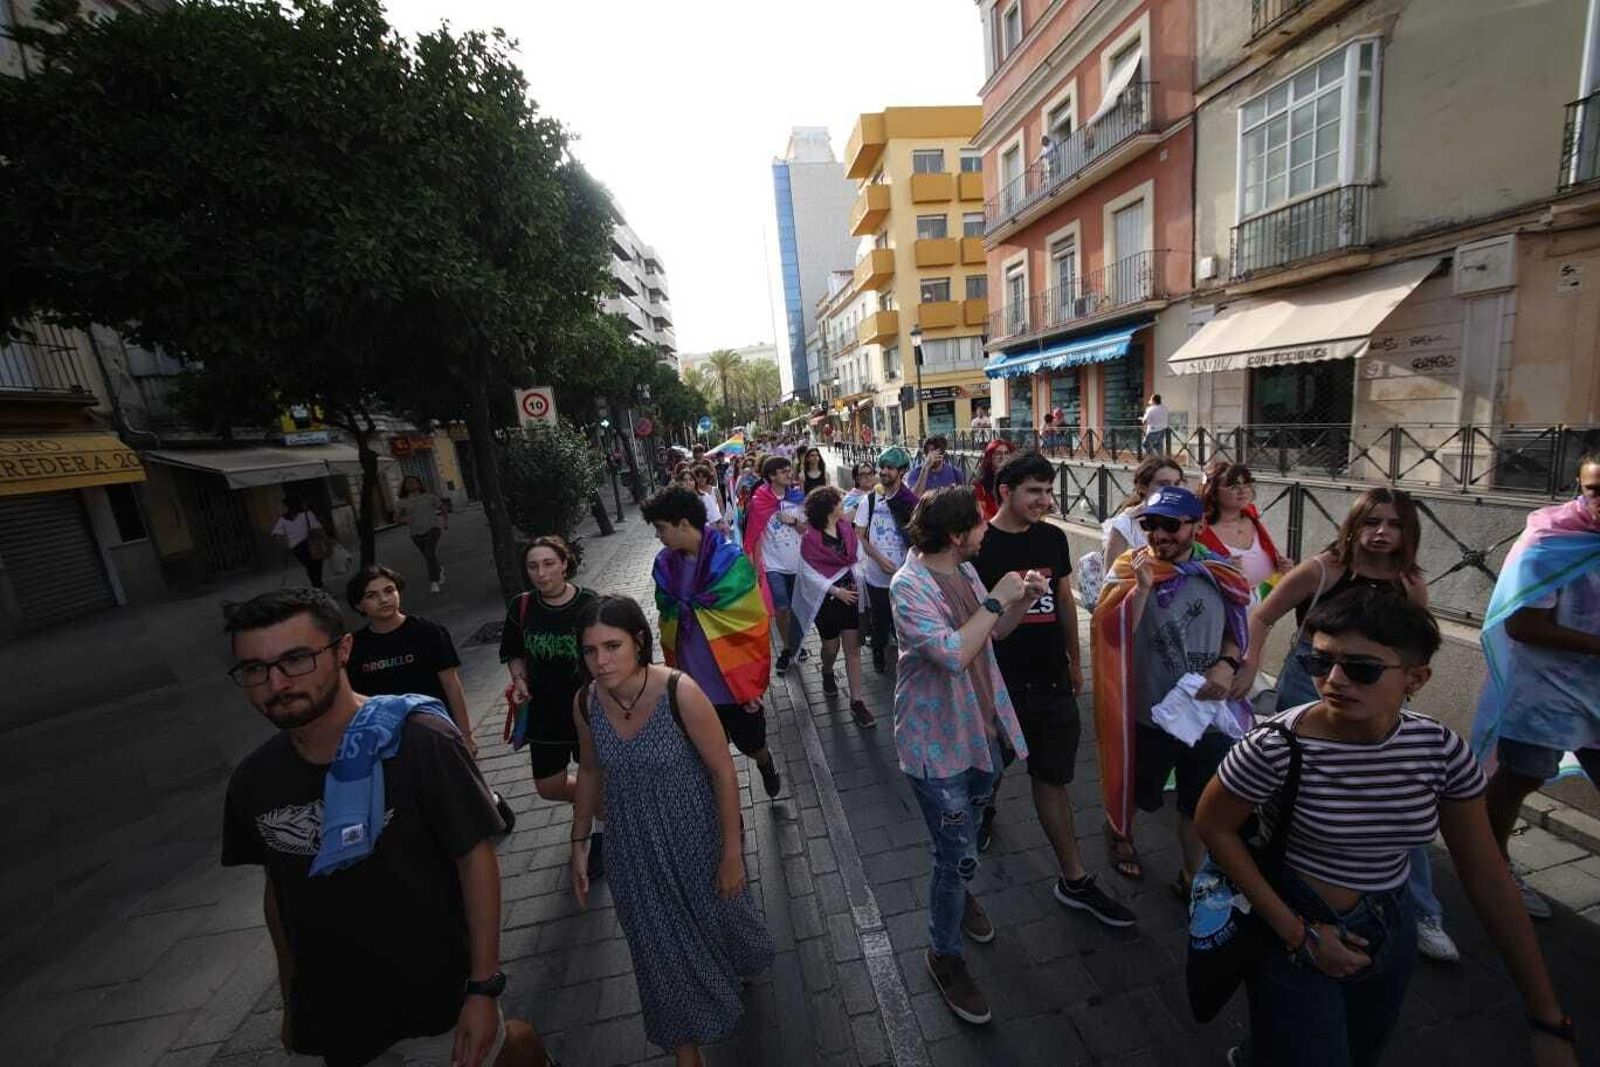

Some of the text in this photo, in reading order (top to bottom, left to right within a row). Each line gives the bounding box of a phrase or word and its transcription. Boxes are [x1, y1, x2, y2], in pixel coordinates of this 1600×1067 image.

[530, 401, 543, 410] 10
[0, 455, 110, 478] REDERA
[361, 654, 414, 672] ORGULLO
